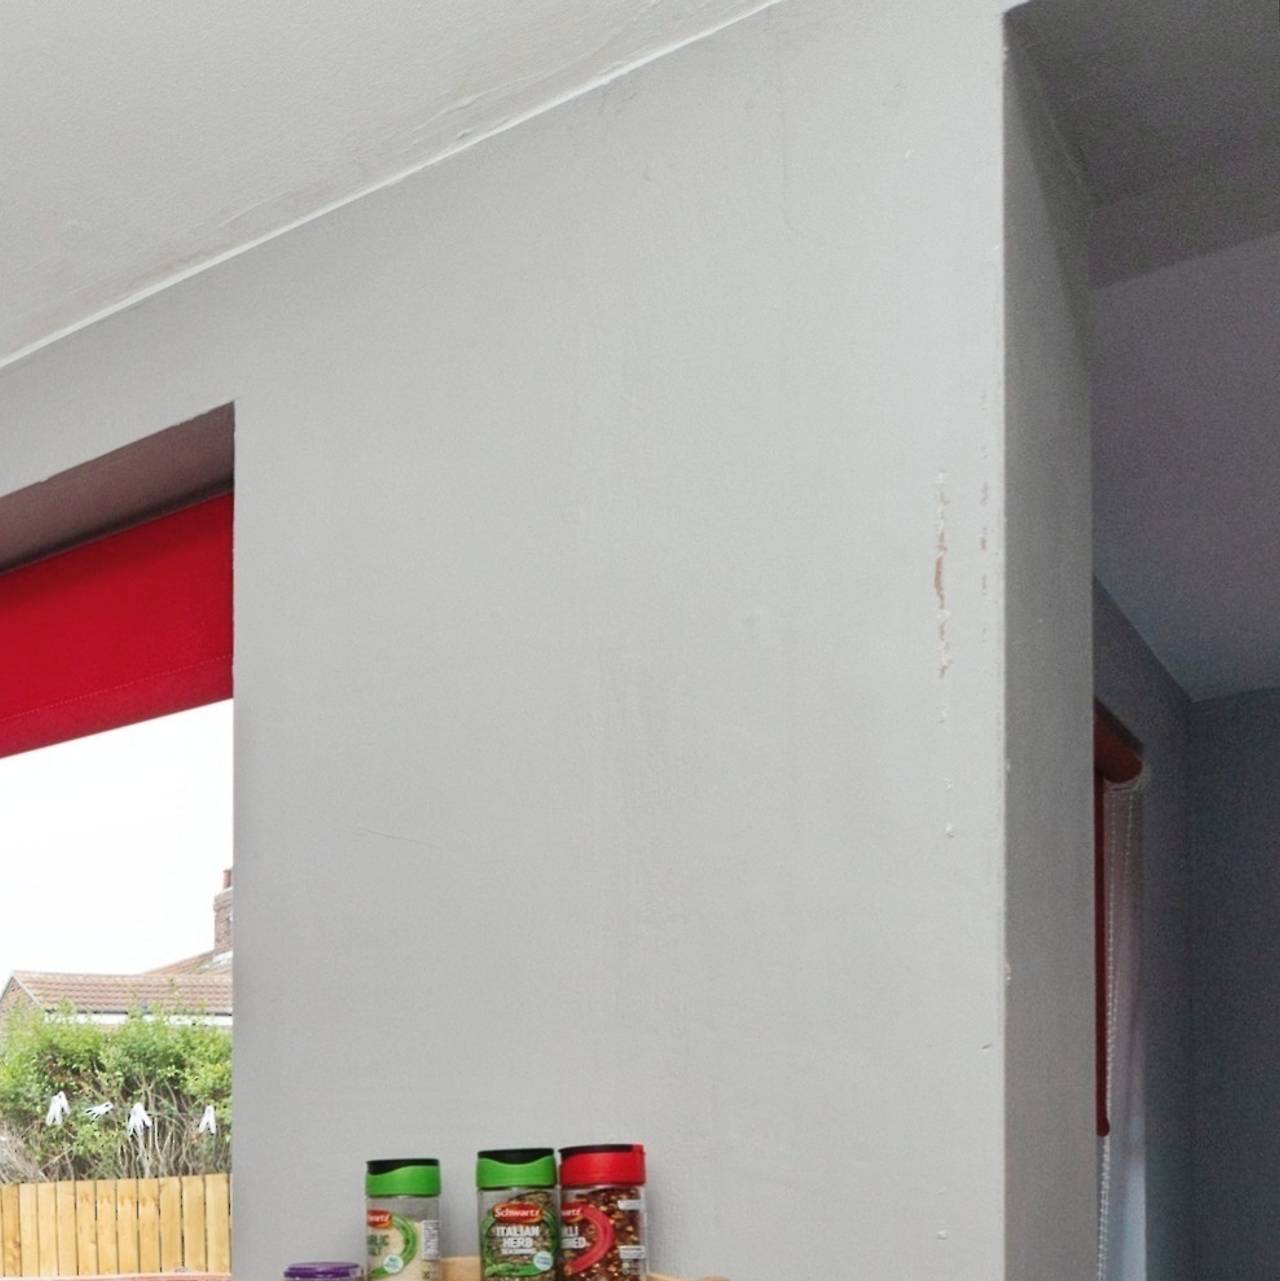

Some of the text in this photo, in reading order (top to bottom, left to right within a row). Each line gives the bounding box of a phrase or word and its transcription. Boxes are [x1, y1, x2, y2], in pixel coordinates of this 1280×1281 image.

[494, 1208, 541, 1218] Schwartz
[496, 1225, 540, 1236] ITALIAN
[503, 1237, 534, 1248] HERB
